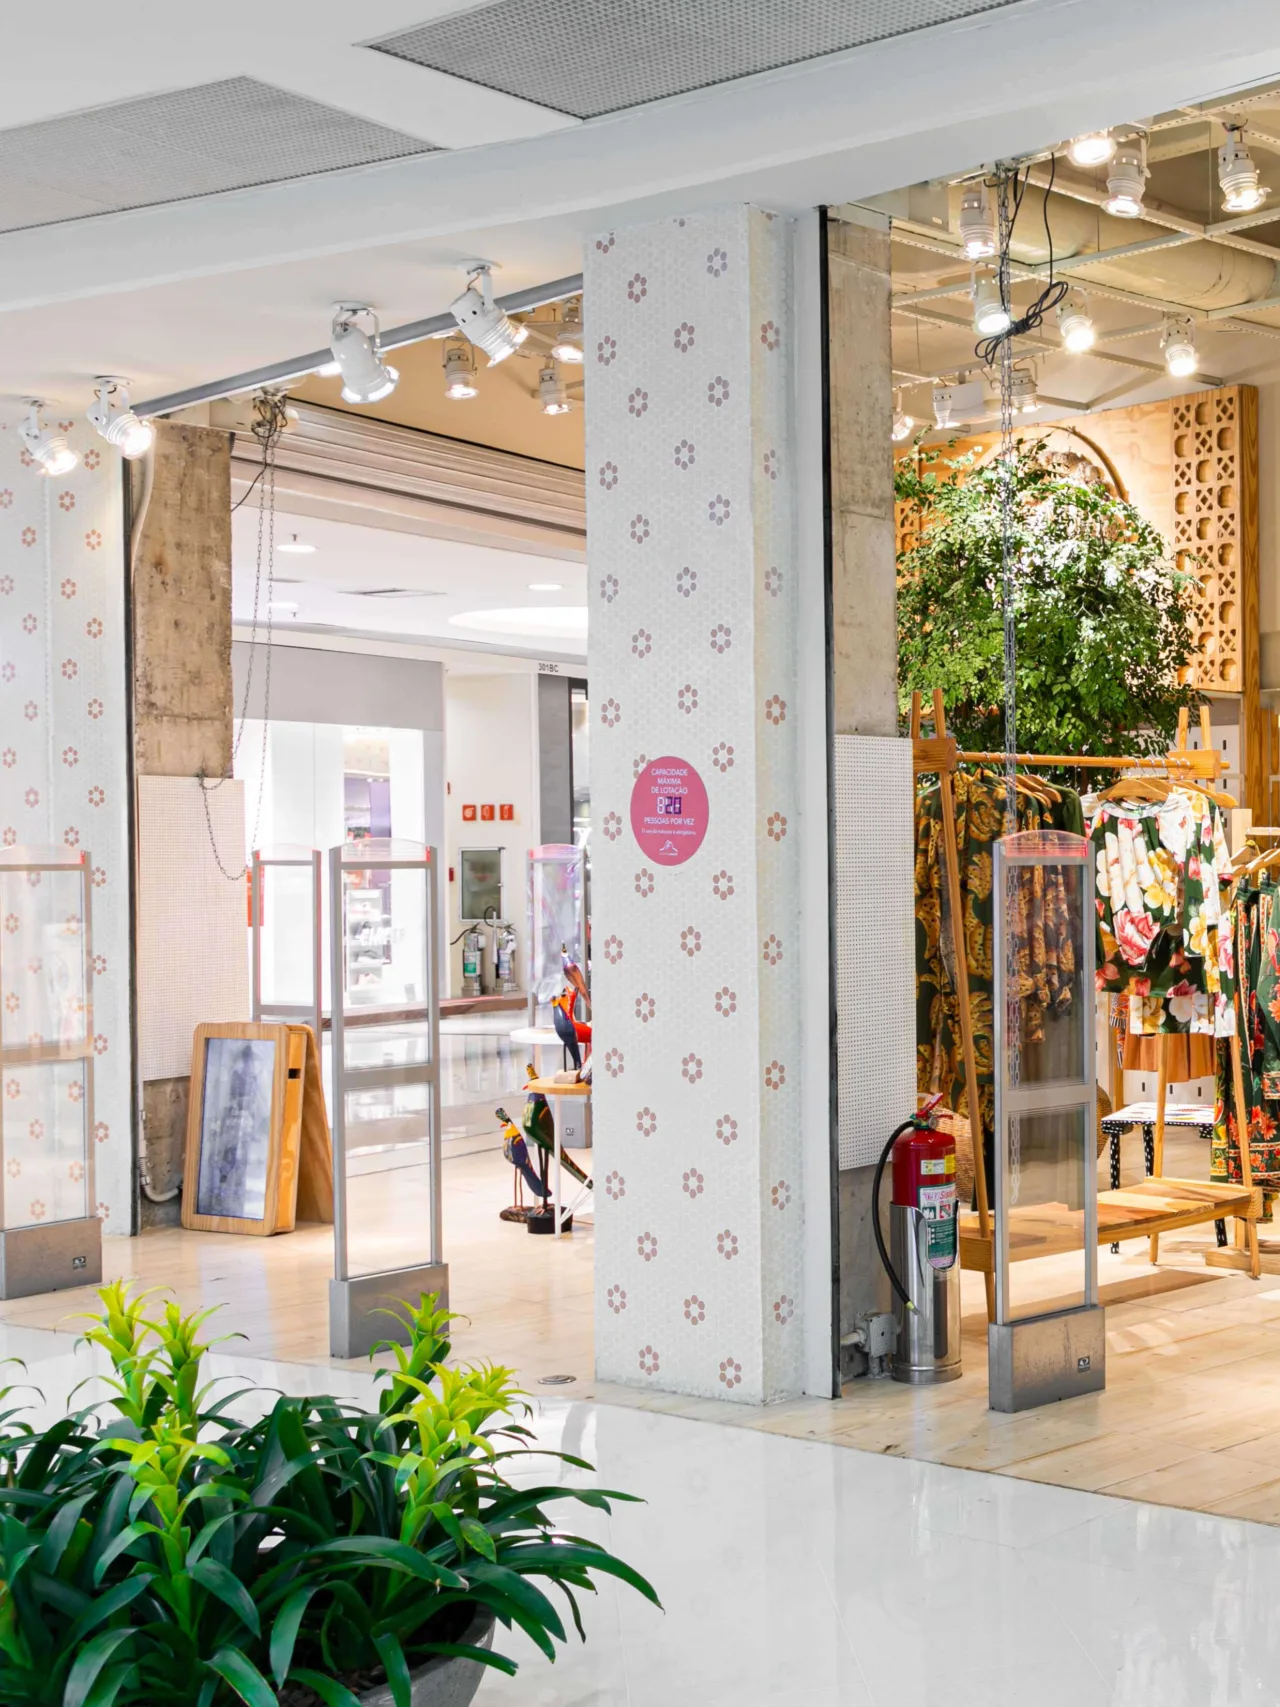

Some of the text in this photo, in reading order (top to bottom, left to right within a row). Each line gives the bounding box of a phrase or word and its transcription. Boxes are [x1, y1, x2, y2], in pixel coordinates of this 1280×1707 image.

[651, 768, 688, 776] CAPACIDADE
[651, 786, 659, 794] DE
[644, 816, 695, 826] PESSOAS POR VEZ
